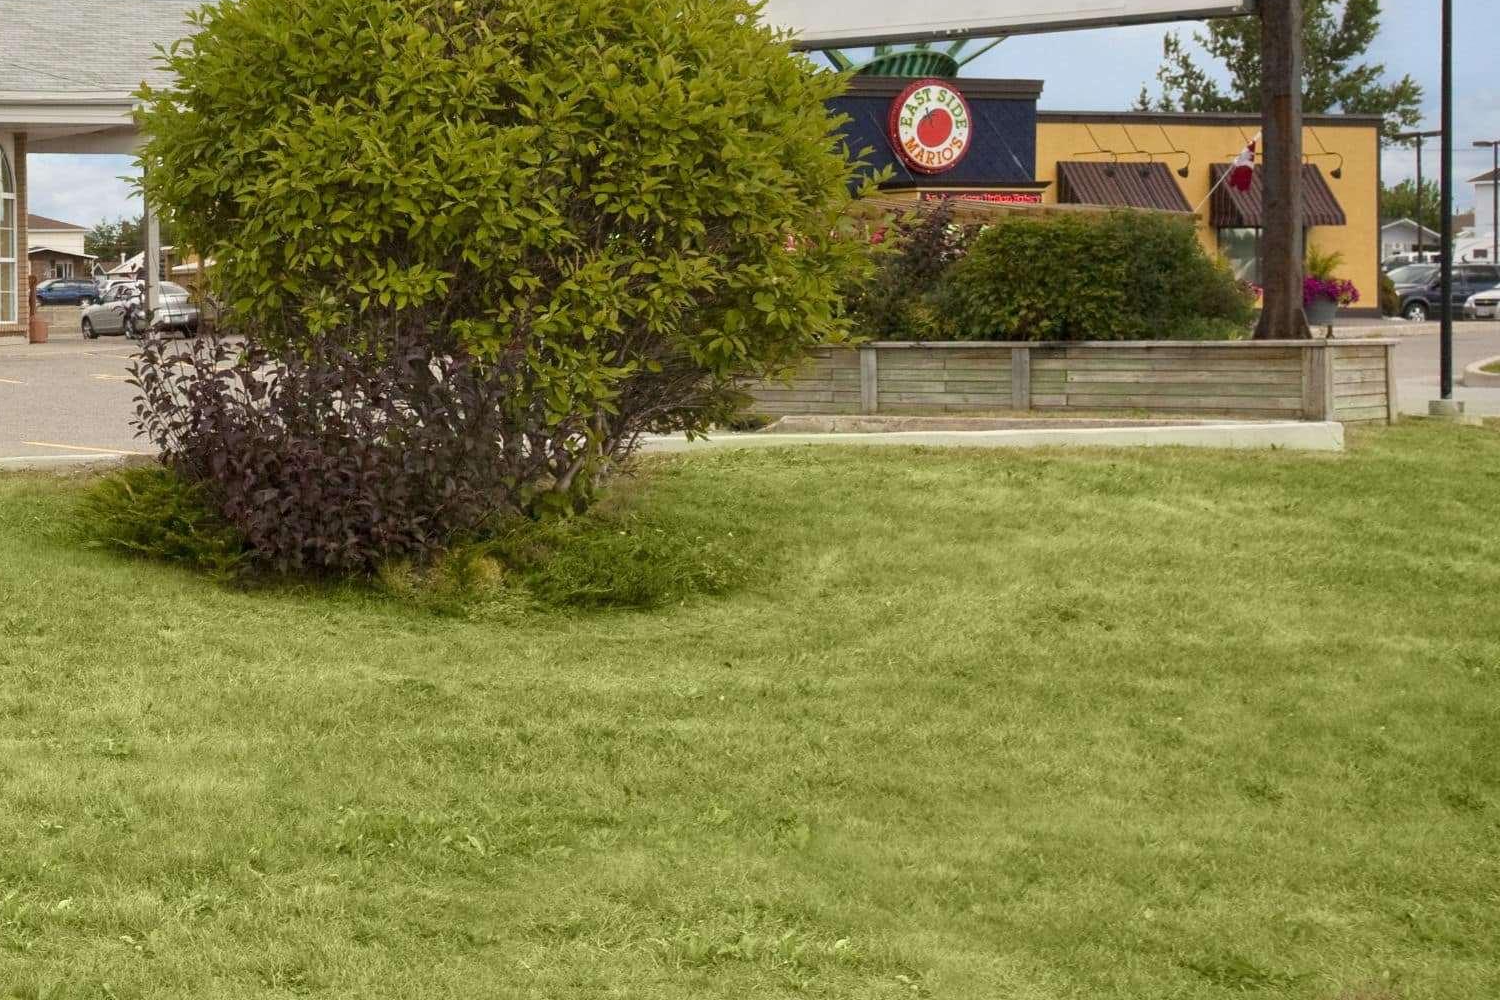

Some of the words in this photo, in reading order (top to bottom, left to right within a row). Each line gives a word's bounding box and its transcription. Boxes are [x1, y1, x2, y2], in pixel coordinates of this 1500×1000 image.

[900, 87, 932, 128] EAST
[937, 89, 967, 129] SIDE
[905, 136, 963, 167] MARIO'S
